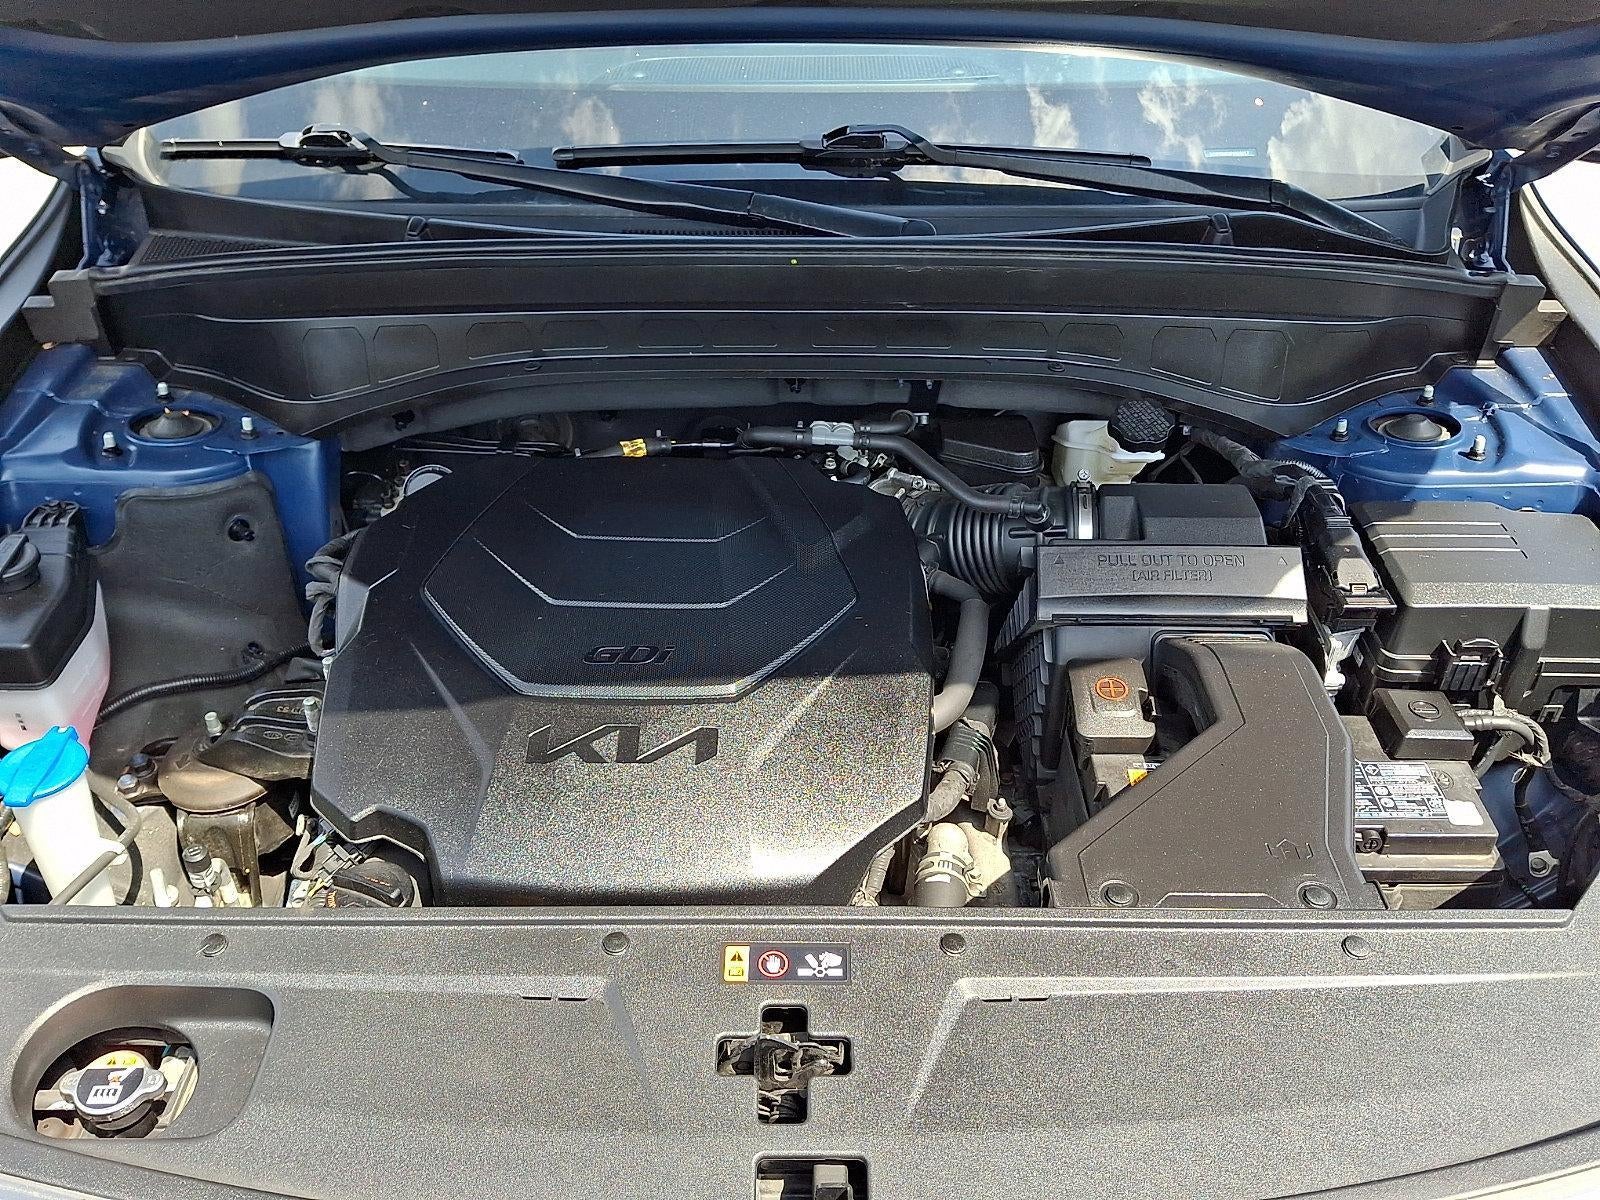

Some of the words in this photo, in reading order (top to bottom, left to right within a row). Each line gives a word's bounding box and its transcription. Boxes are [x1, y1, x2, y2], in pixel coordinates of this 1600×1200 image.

[1097, 554, 1137, 567] PULL
[1141, 554, 1174, 567] OUT
[1179, 554, 1198, 567] TO
[1201, 554, 1246, 567] OPEN
[525, 723, 718, 765] KIA
